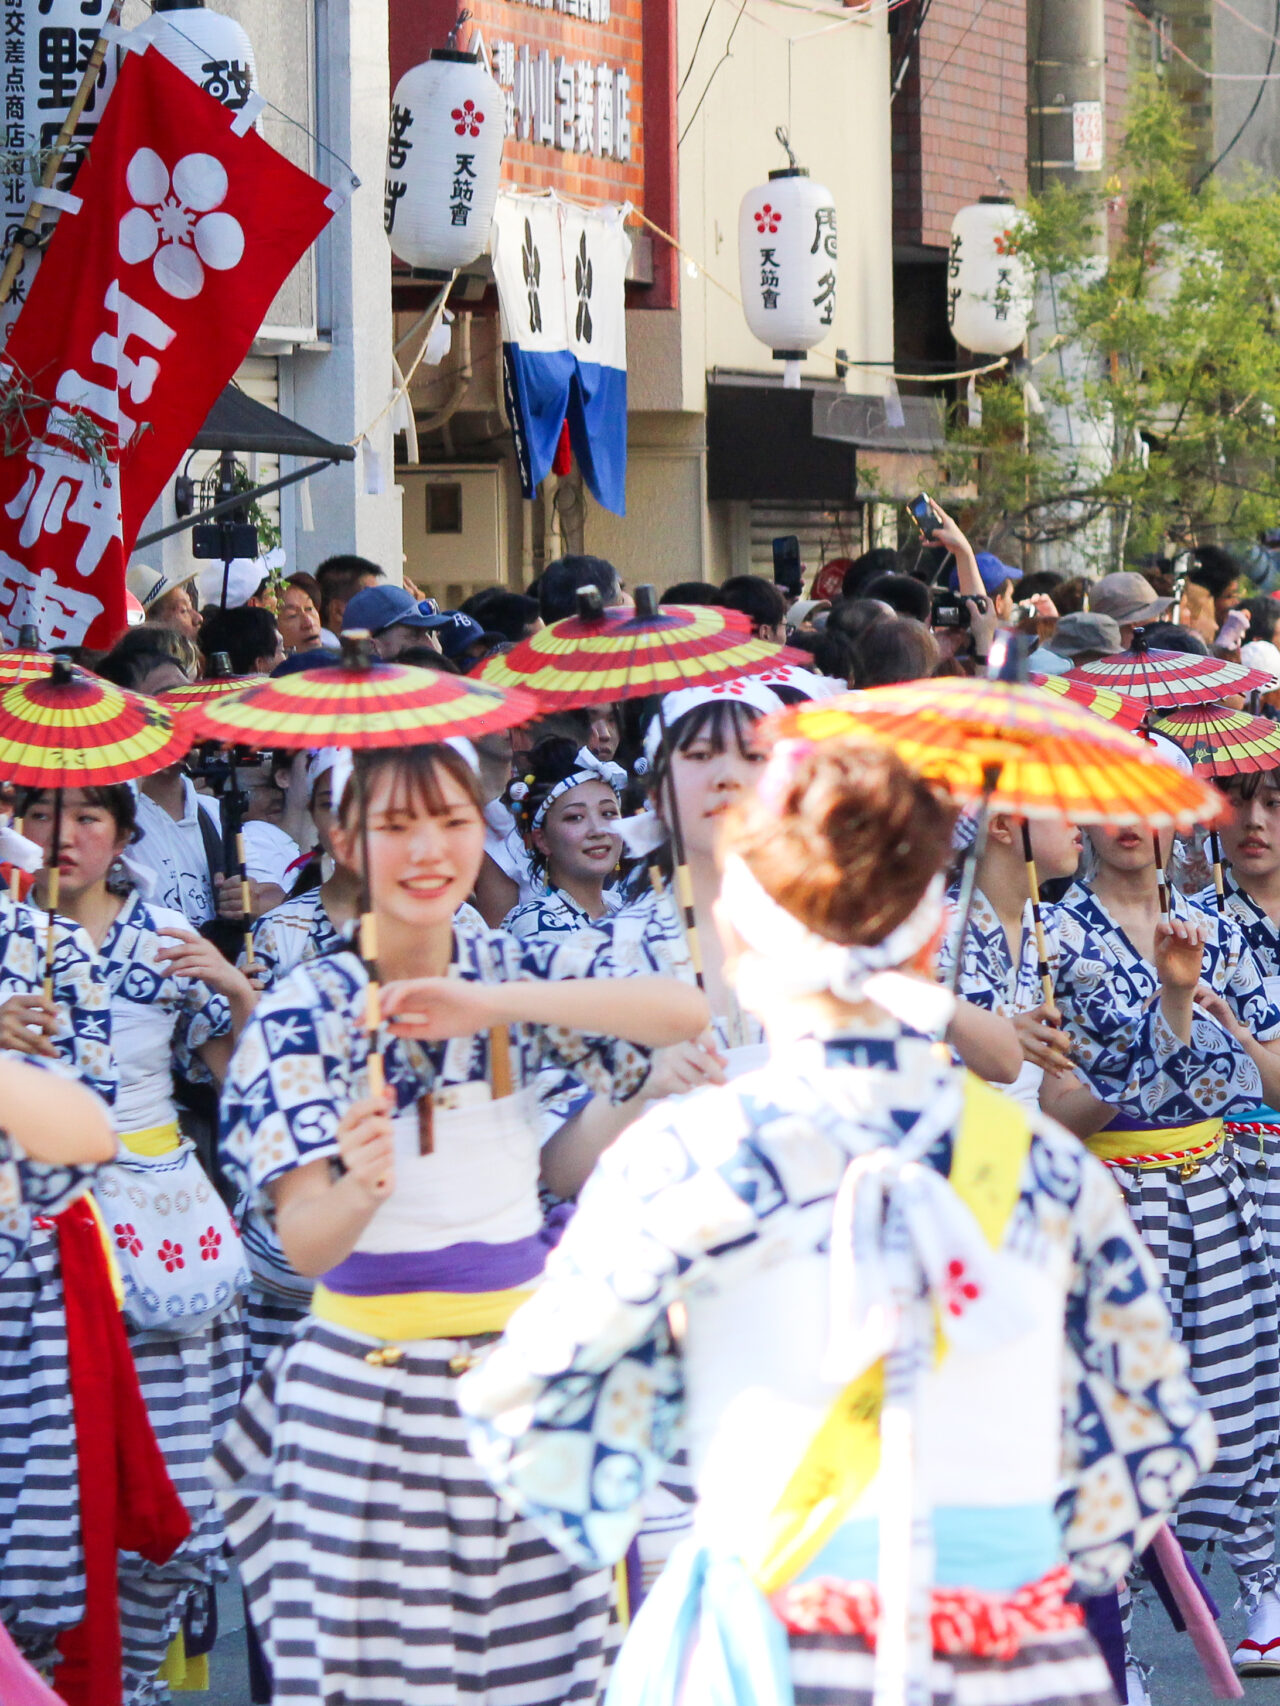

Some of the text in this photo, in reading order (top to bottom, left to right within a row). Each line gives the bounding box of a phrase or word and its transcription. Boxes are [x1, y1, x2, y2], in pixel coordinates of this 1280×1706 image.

[450, 153, 477, 226] 天筋會
[760, 248, 780, 309] 天筋會
